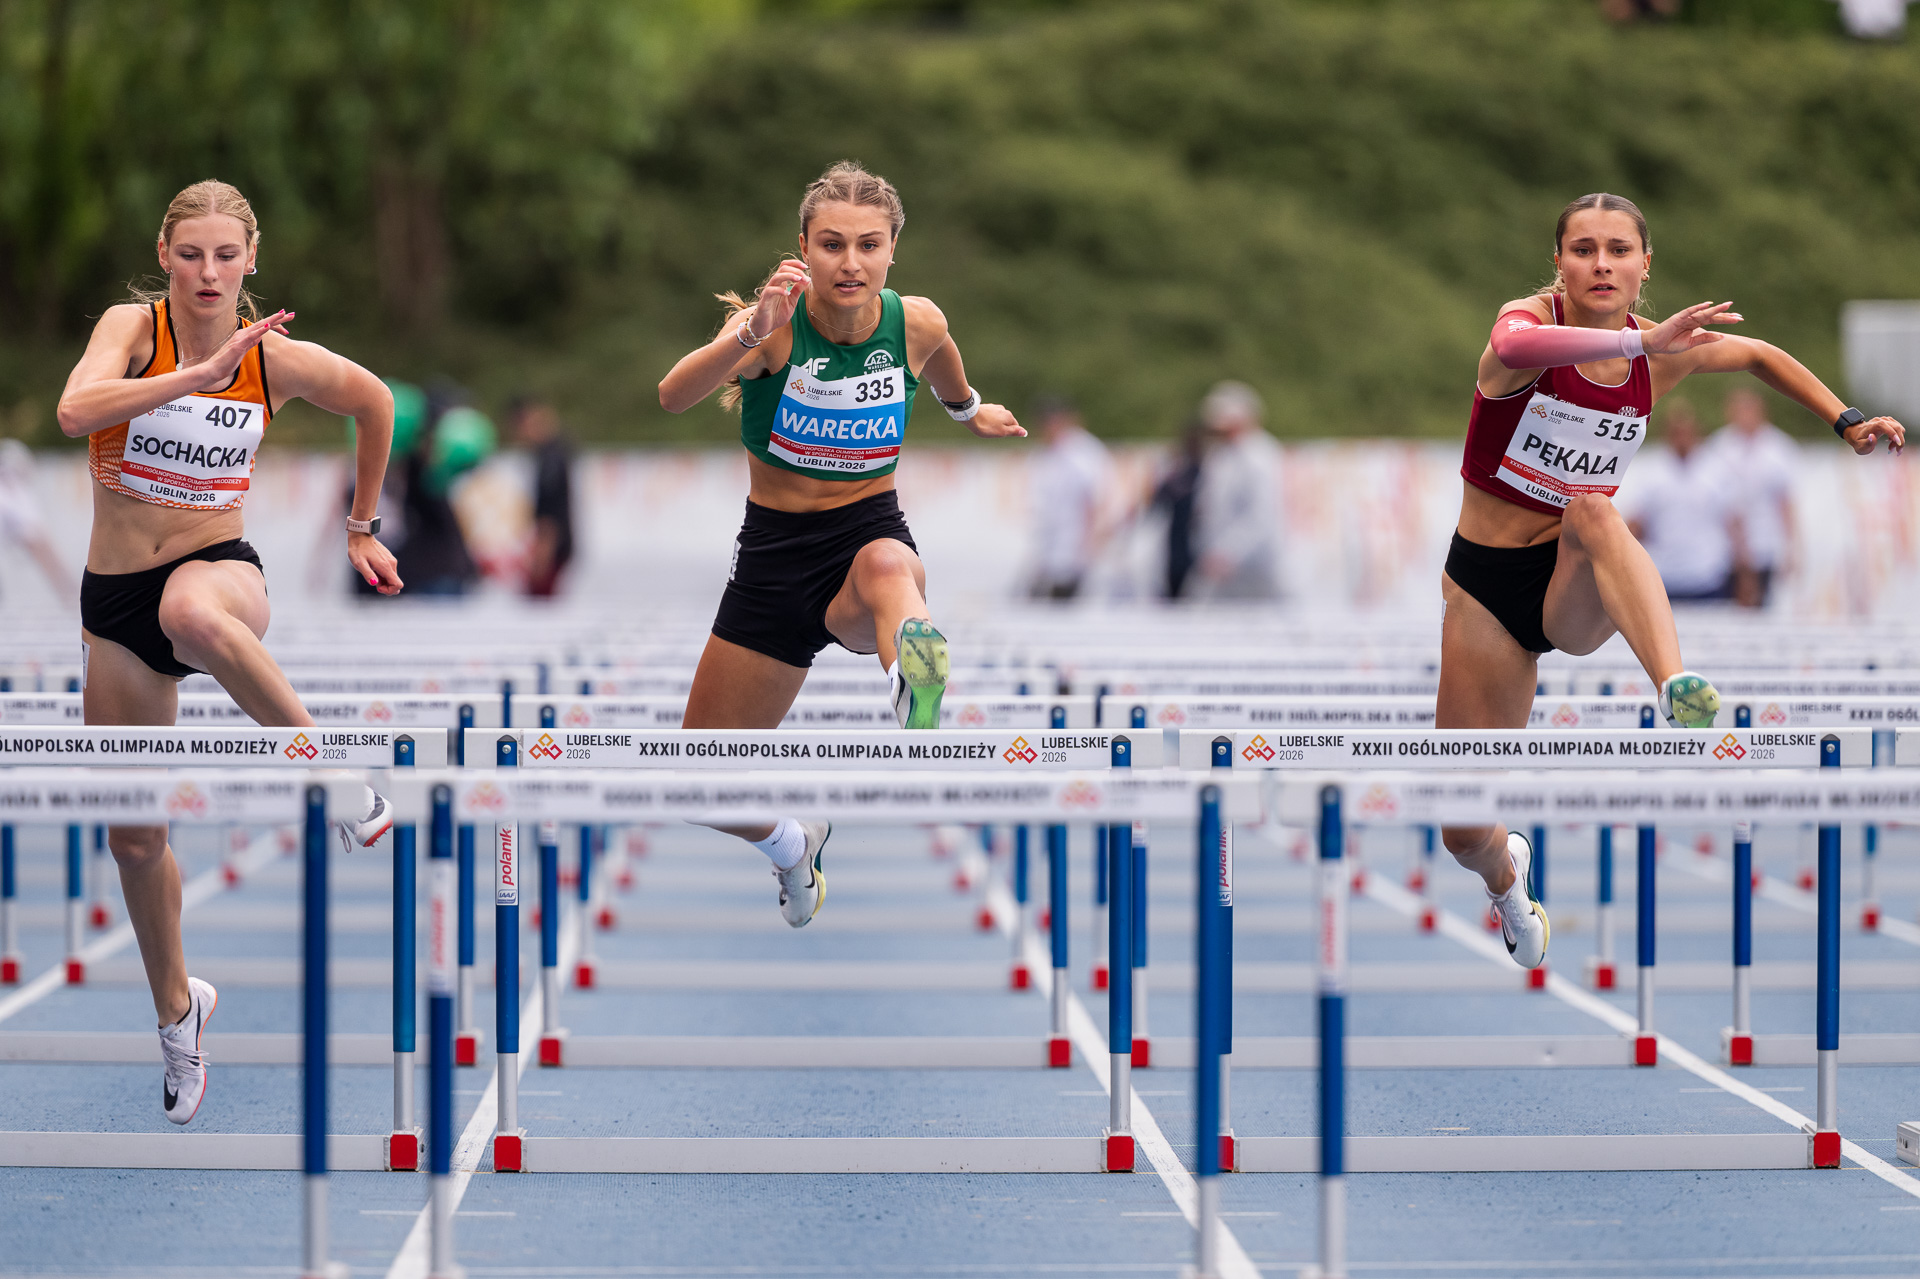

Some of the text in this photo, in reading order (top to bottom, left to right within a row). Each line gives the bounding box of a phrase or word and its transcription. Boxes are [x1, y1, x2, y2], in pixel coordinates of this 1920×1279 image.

[870, 354, 888, 366] AZS
[807, 376, 894, 403] LUBELSKIE 335
[806, 392, 820, 401] 2026
[205, 405, 252, 430] 407
[782, 407, 898, 440] WARECKA
[1547, 416, 1562, 426] 2026
[1550, 409, 1640, 442] LUBELSKIE 515
[130, 434, 247, 468] SOCHACKA
[812, 451, 841, 459] SPORTACH
[1521, 432, 1619, 475] PĘKALA
[797, 457, 866, 470] LUBLIN 2026
[129, 463, 144, 472] XXXII
[143, 466, 187, 482] OGÓLNOPOLSKA
[1522, 466, 1565, 488] OGÓLNOPOLSKA
[163, 478, 193, 490] SPORTACH
[1541, 480, 1570, 496] SPORTACH
[149, 483, 217, 503] LUBLIN 2026
[1524, 483, 1564, 505] LUBLIN
[101, 740, 185, 753] OLIMPIADA
[191, 738, 277, 754] MŁODZIEŻY
[323, 734, 388, 745] LUBELSKIE
[567, 735, 631, 746] LUBELSKIE
[1042, 737, 1108, 748] LUBELSKIE
[1280, 736, 1344, 746] LUBELSKIE
[1751, 735, 1816, 745] LUBELSKIE
[640, 740, 996, 758] XXXII OGÓLNOPOLSKA OLIMPIADA MŁODZIEŻY
[1352, 739, 1705, 755] XXXII OGÓLNOPOLSKA OLIMPIADA MŁODZIEŻY
[323, 749, 346, 759] 2026
[567, 749, 590, 759] 2026
[1042, 752, 1066, 762] 2026
[1280, 751, 1303, 760] 2026
[1751, 750, 1774, 759] 2026
[500, 827, 514, 886] polanik
